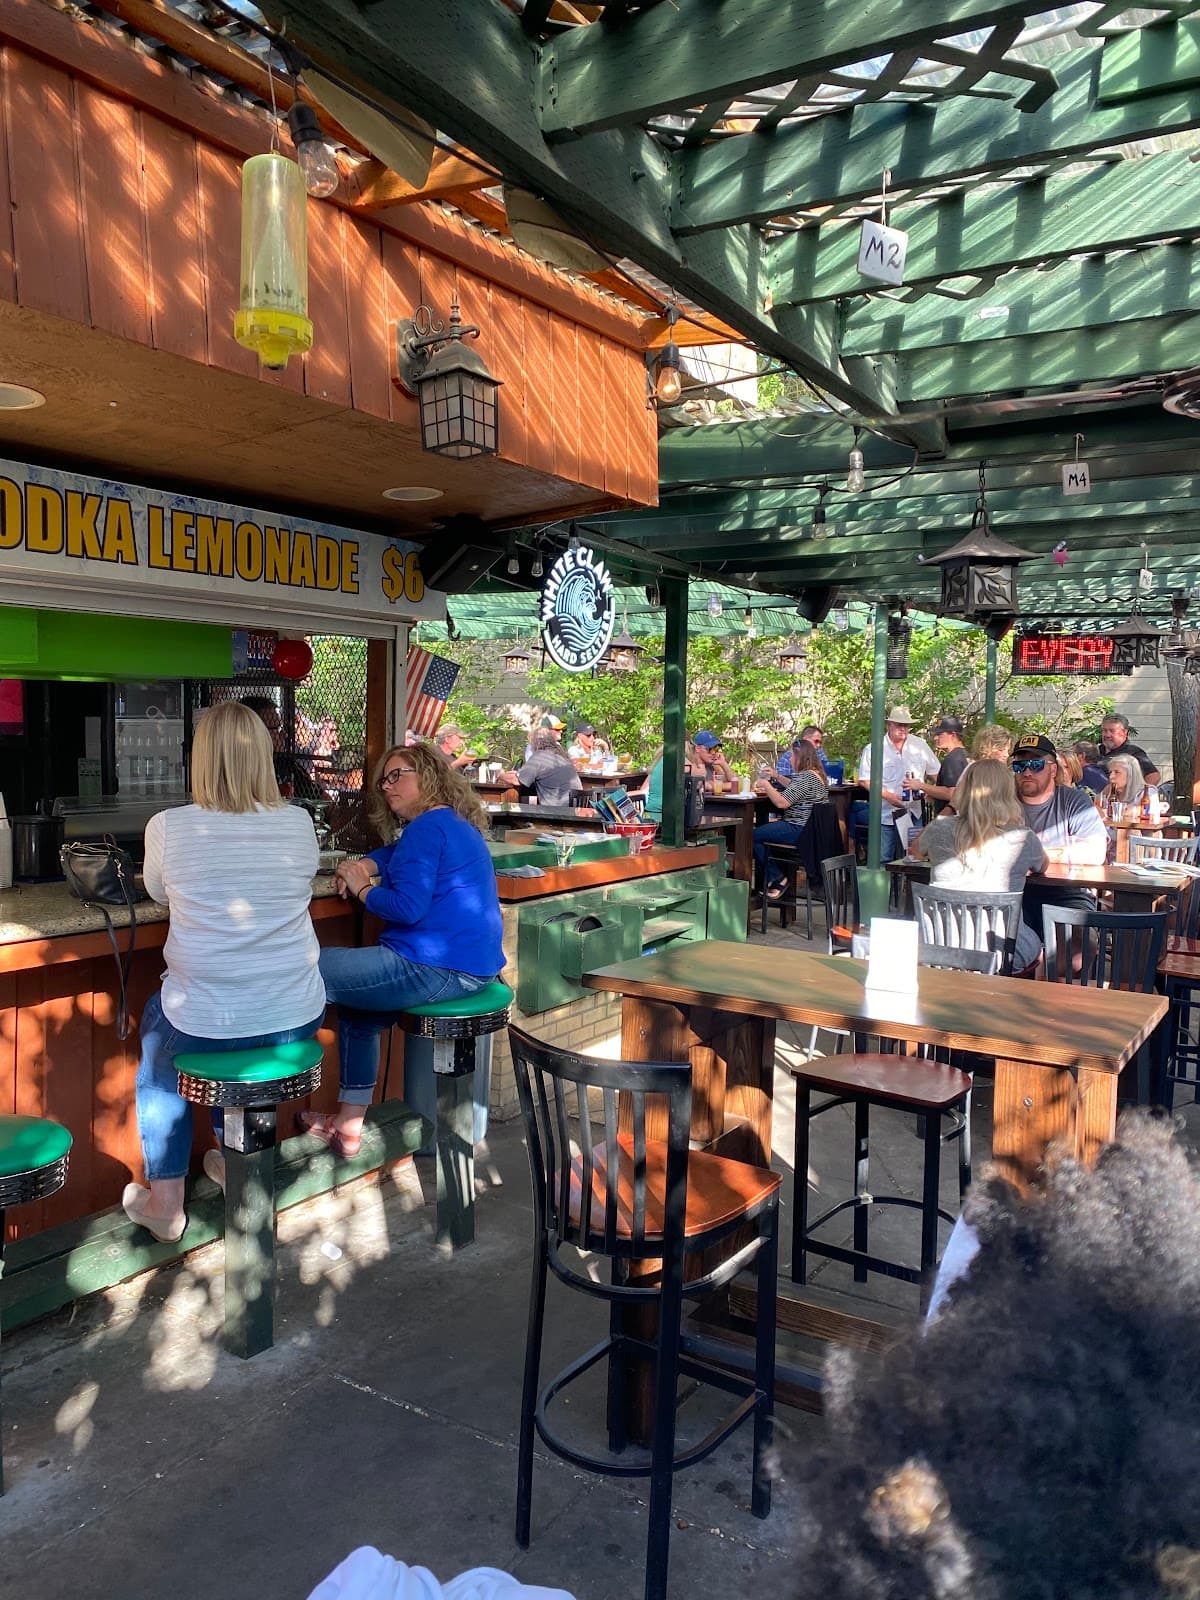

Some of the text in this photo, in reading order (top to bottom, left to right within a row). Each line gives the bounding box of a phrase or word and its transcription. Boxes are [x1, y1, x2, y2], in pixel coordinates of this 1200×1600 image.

[865, 235, 902, 269] M2
[1068, 472, 1087, 487] M4
[147, 503, 360, 594] LEMONADE
[381, 544, 425, 604] $6
[542, 546, 614, 621] WHITE CLAW
[552, 610, 612, 664] HARD SELTZER
